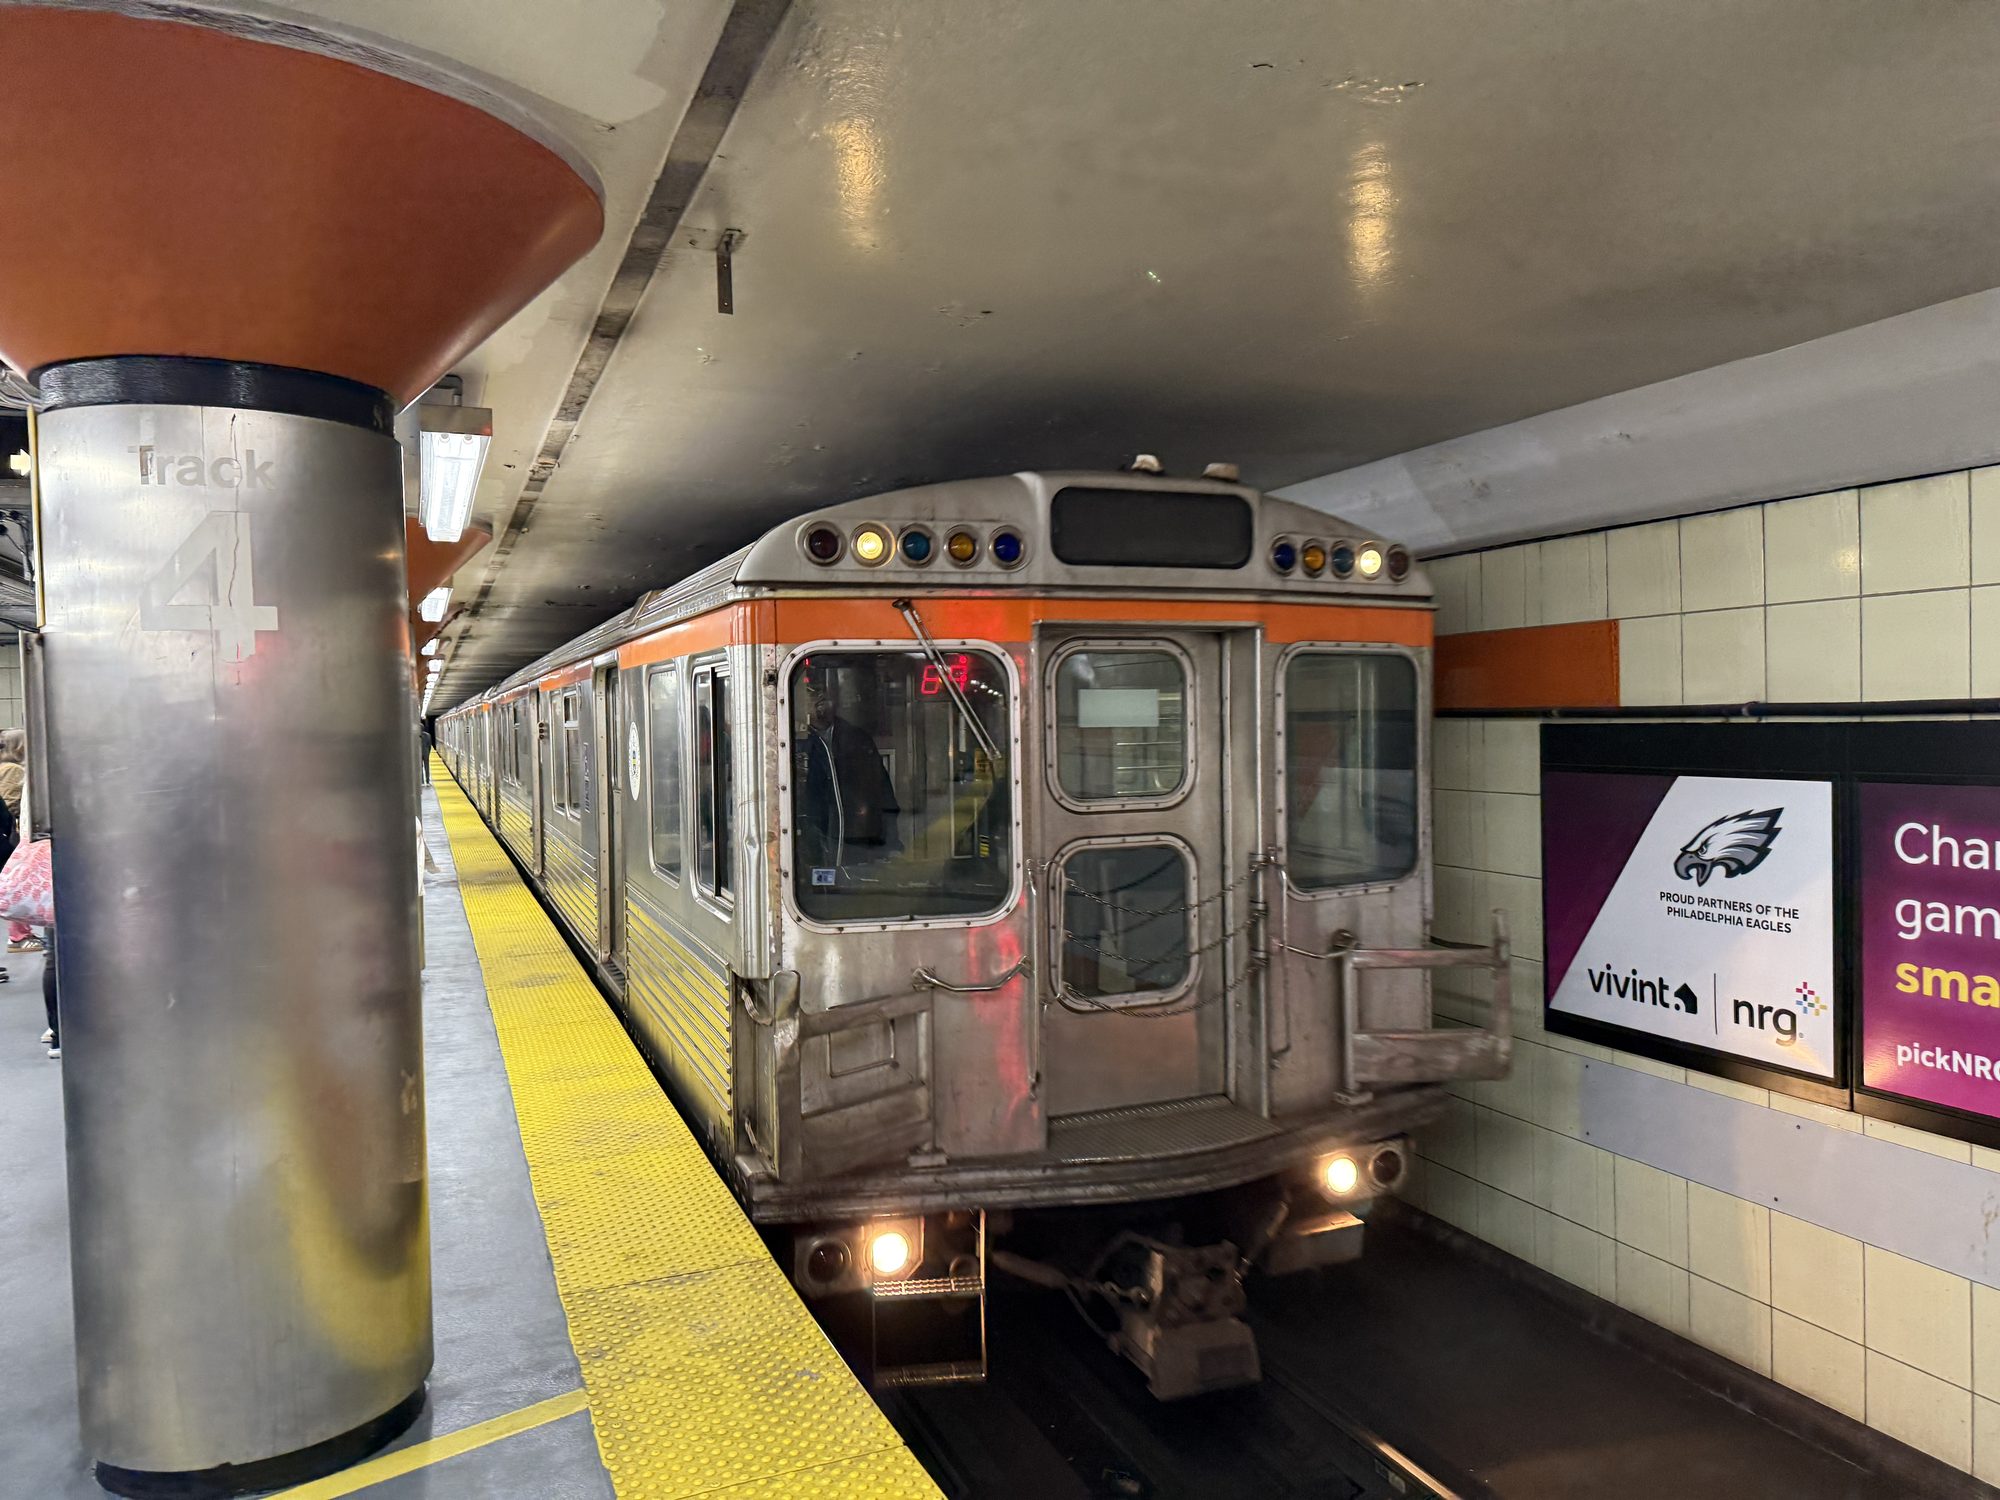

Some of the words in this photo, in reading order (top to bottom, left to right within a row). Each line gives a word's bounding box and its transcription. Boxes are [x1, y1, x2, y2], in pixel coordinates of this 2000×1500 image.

[128, 444, 275, 489] Track
[139, 510, 279, 663] 4
[1659, 891, 1695, 905] PROUD
[1697, 896, 1753, 913] PARTNERS
[1755, 904, 1772, 916] OF
[1774, 906, 1800, 920] THE
[1666, 906, 1744, 927] PHILADELPHIA
[1746, 917, 1792, 933] EAGLES
[1895, 899, 2000, 941] gam
[1895, 962, 2000, 1009] sma
[1733, 998, 1798, 1047] nrg
